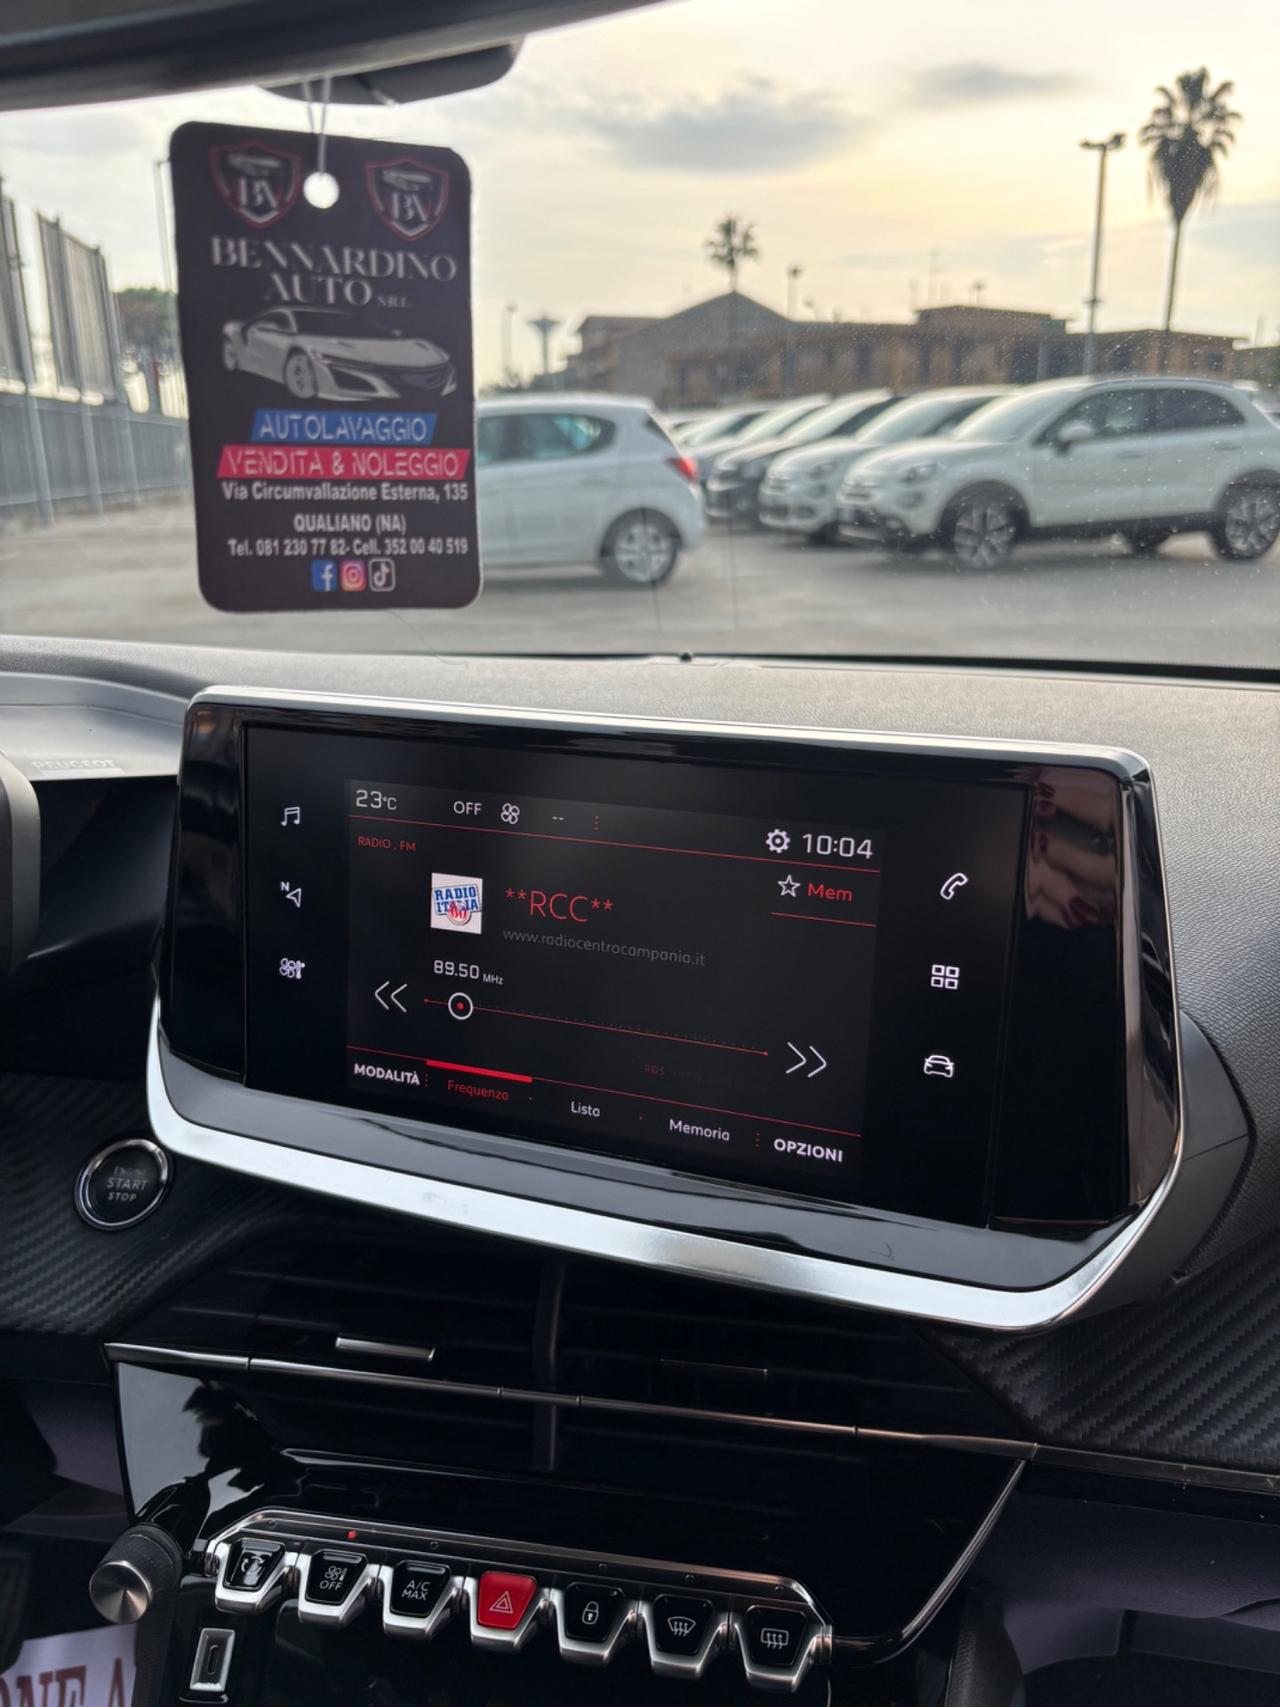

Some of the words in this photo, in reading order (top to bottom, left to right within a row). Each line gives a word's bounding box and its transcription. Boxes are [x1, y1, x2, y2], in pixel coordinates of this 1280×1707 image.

[211, 237, 457, 282] BENNARDINO
[264, 272, 372, 305] AUTO
[259, 414, 428, 442] AUTOLAVAGGIO
[226, 450, 325, 476] VENDITA
[331, 451, 344, 476] &
[352, 452, 459, 478] NOLEGGIO
[221, 482, 248, 500] Via
[251, 482, 377, 501] Circumvallazione
[381, 482, 440, 503] Esterna,
[444, 483, 468, 500] 135
[293, 514, 372, 533] QUALIANO
[376, 514, 406, 535] (NA)
[227, 539, 253, 556] Tel.
[256, 538, 279, 556] 081
[283, 538, 308, 556] 230
[311, 538, 327, 556] 77
[353, 538, 380, 556] Cell.
[384, 538, 408, 555] 352
[409, 538, 426, 555] 00
[427, 538, 444, 554] 40
[446, 537, 469, 555] 519
[453, 800, 483, 816] OFF
[357, 835, 391, 850] RADIO
[400, 840, 417, 852] FM
[802, 833, 874, 860] 10:04
[434, 886, 476, 900] RADIO
[807, 882, 854, 902] Mem
[502, 929, 706, 966] www.radiocentrocampania.it
[433, 959, 480, 983] 89.50
[482, 973, 504, 986] MHz
[353, 1063, 421, 1086] MODALITÀ
[447, 1079, 509, 1101] Frequenza
[570, 1100, 601, 1118] Lista
[668, 1118, 731, 1142] Memoria
[773, 1138, 844, 1163] OPZIONI
[107, 1177, 148, 1190] START
[107, 1191, 137, 1202] STOP
[319, 1580, 342, 1590] OFF
[401, 1589, 428, 1600] MAX
[406, 1579, 431, 1591] A/C
